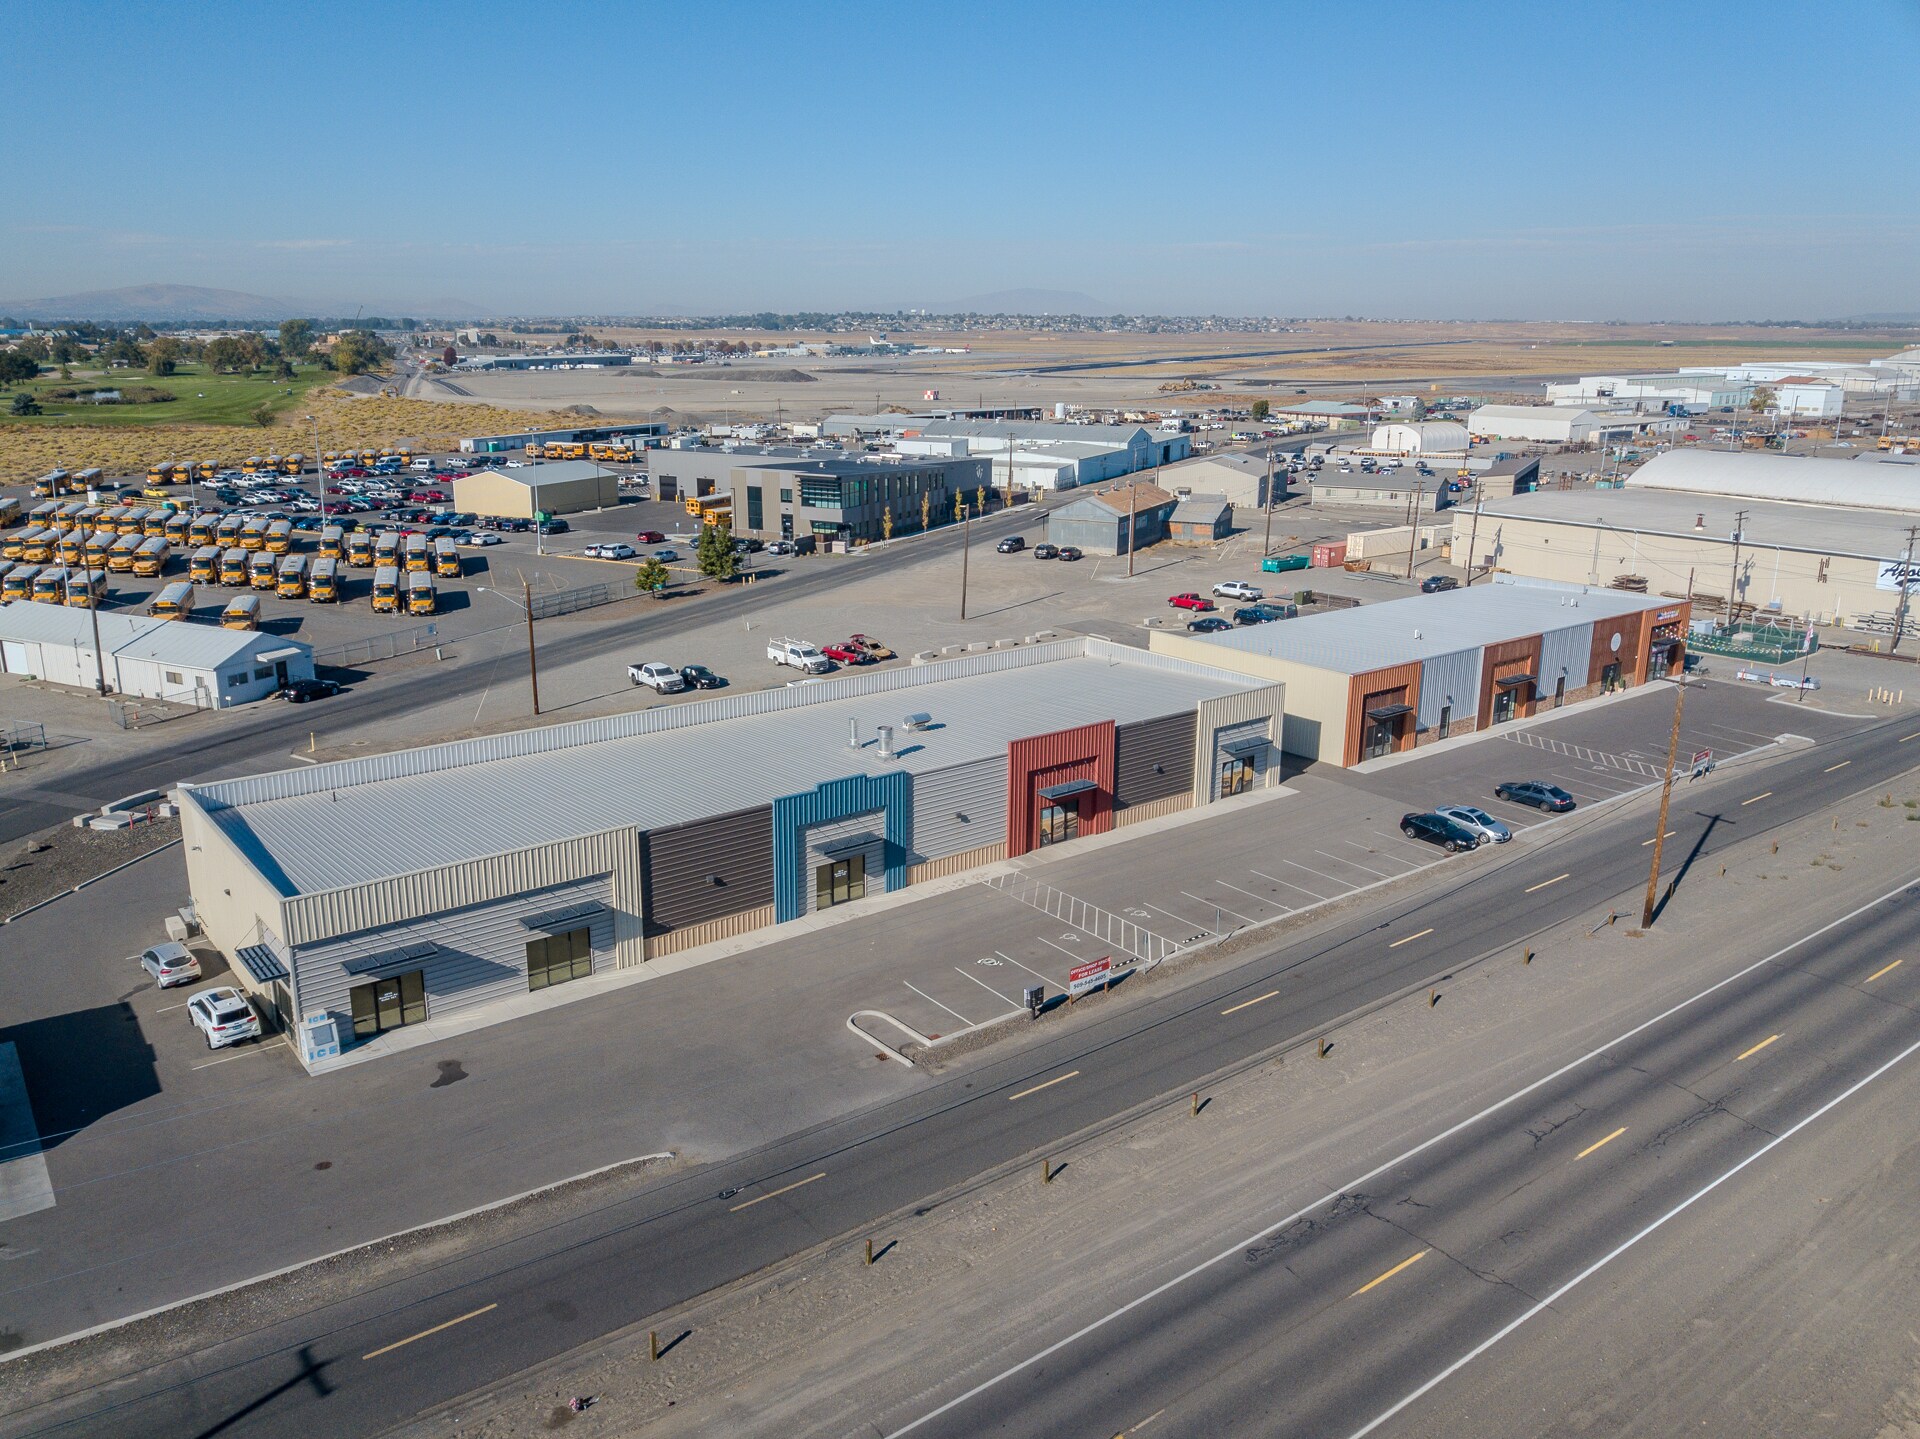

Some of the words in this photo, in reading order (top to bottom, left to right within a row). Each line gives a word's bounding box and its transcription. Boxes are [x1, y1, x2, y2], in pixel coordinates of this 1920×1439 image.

[1078, 971, 1089, 979] FOR
[1089, 966, 1103, 975] LEASE
[308, 1014, 326, 1024] ICE
[309, 1045, 338, 1060] ICE
